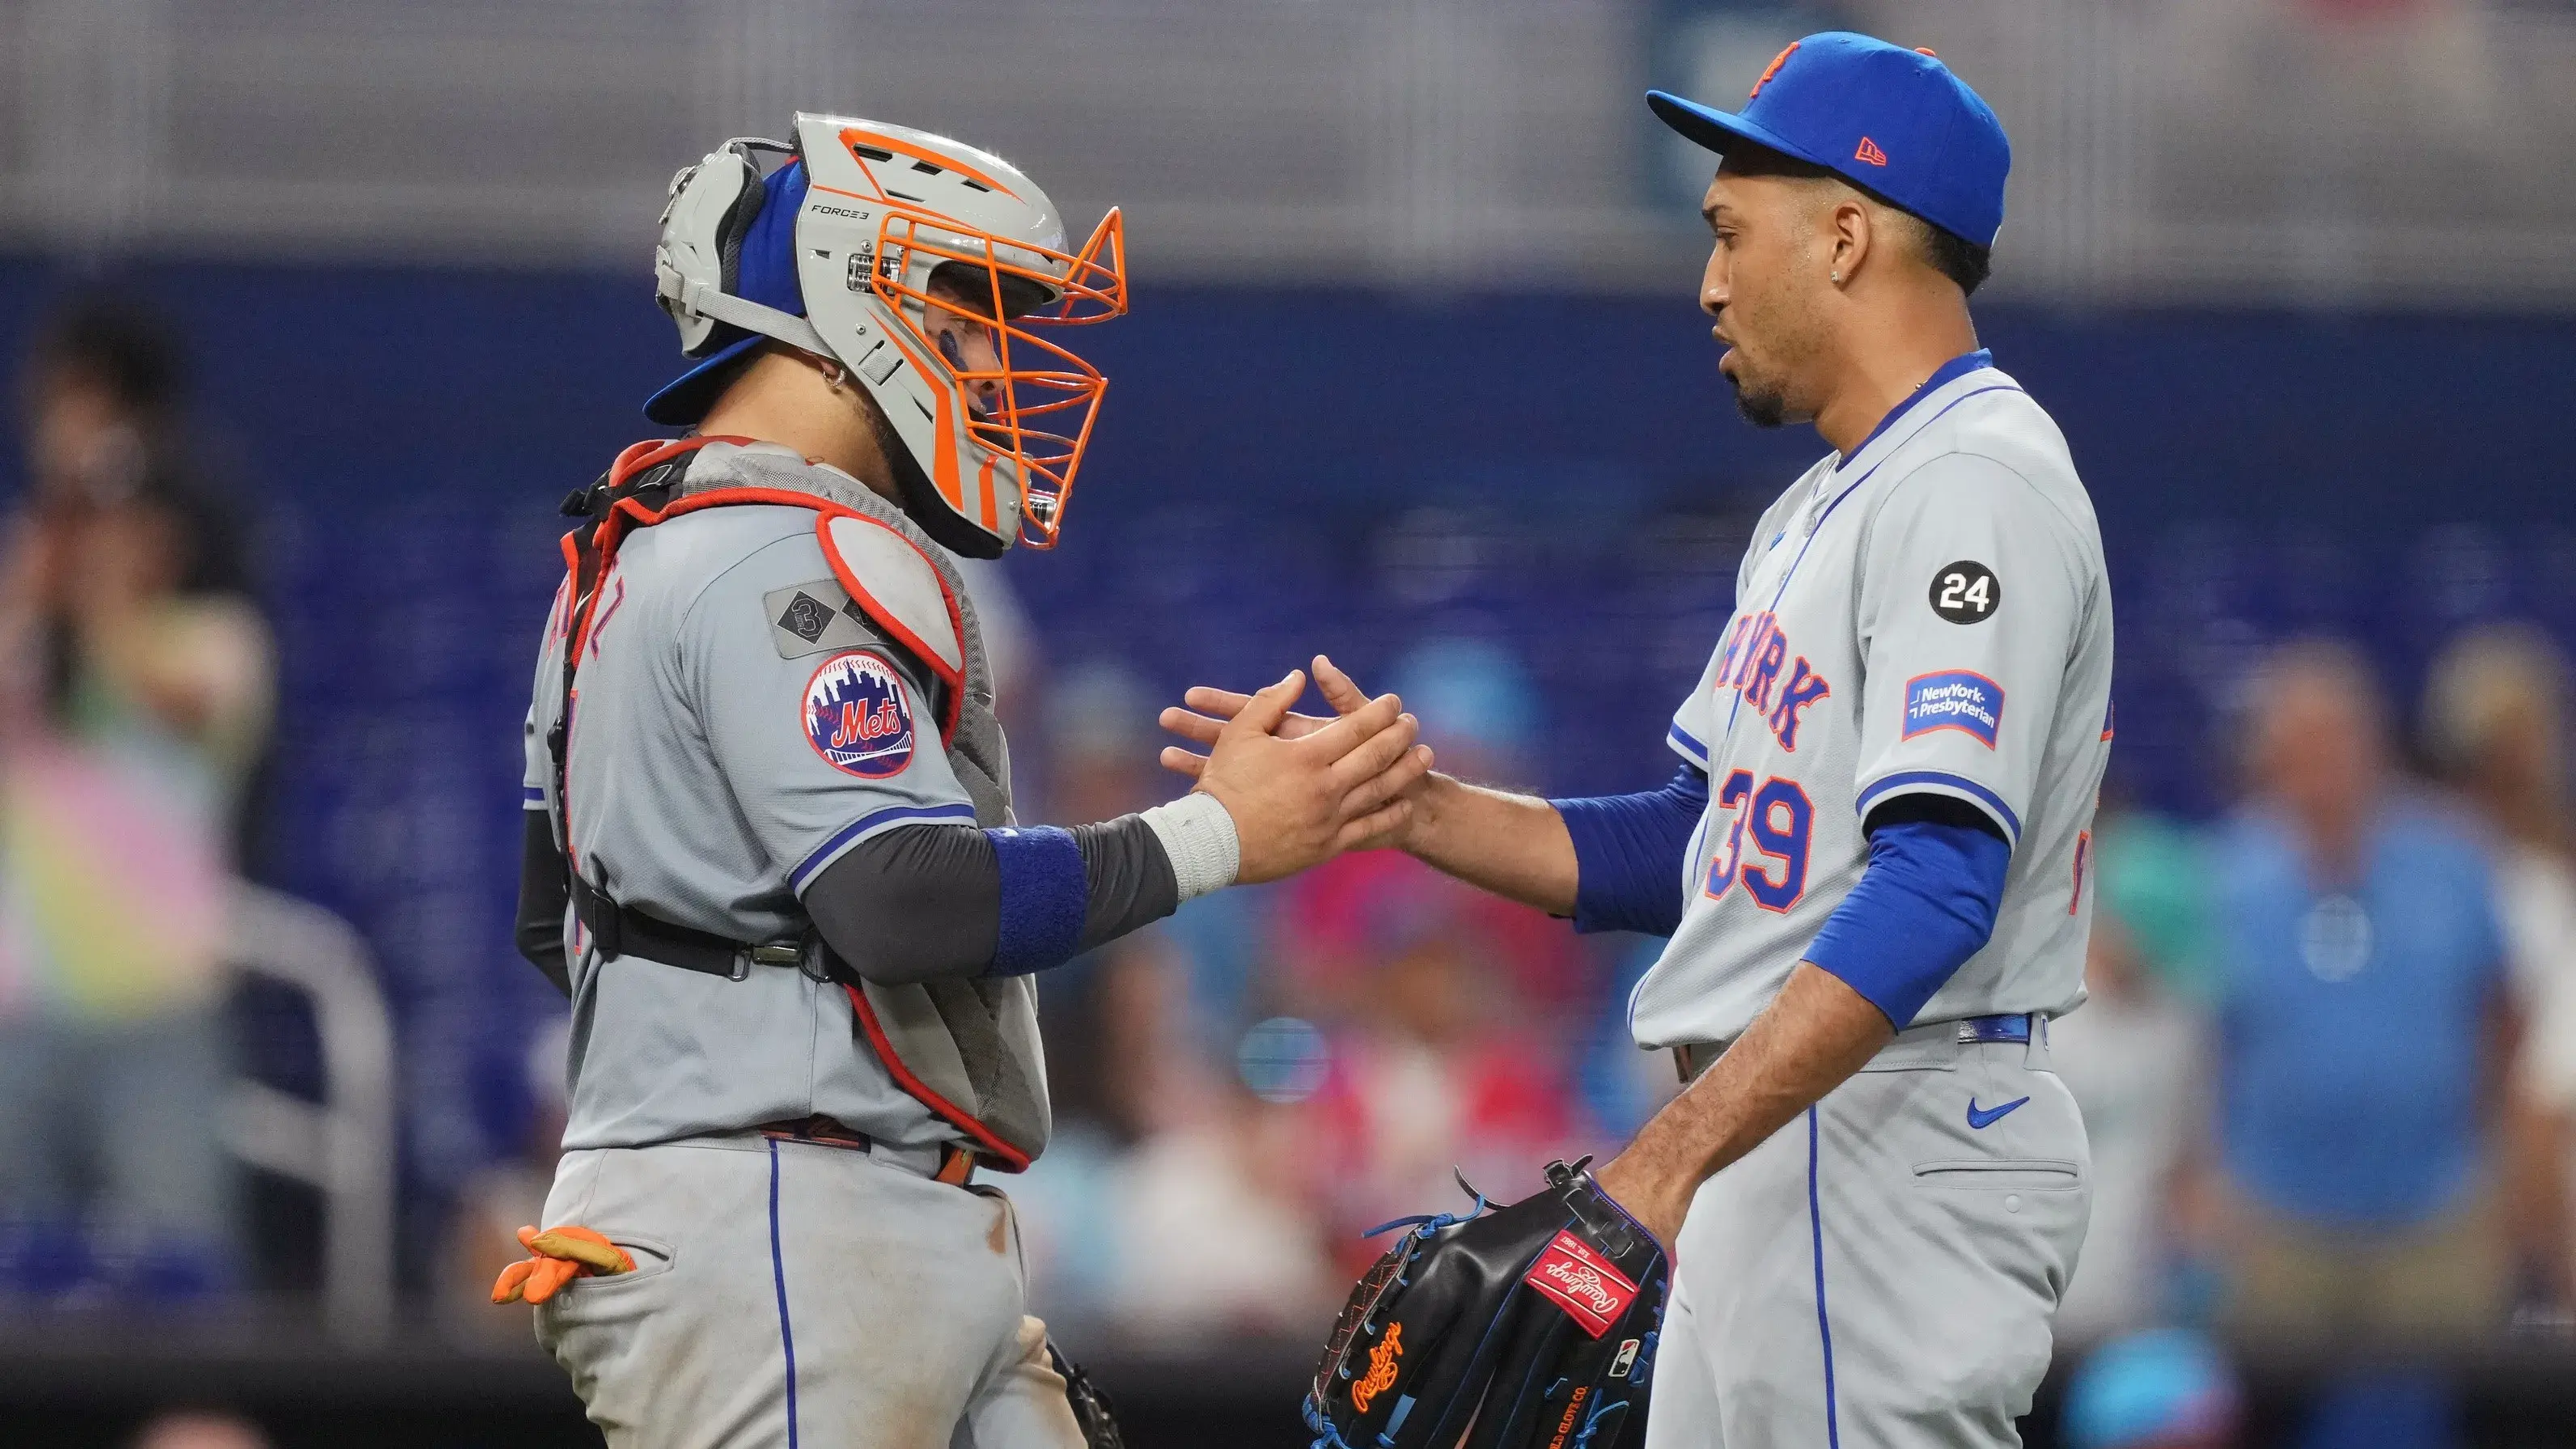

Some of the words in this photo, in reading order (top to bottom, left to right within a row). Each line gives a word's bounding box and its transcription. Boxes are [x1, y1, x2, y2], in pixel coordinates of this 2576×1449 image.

[811, 205, 870, 220] FORCE3
[1939, 573, 1990, 612] 24
[791, 598, 823, 638] 3
[831, 697, 901, 748] Mets
[1919, 697, 1995, 728] Presbyterian
[1704, 768, 1815, 914] 39
[1560, 1236, 1577, 1250] 1887
[1545, 1261, 1619, 1313] Rawlings
[1352, 1321, 1404, 1413] Rawlings
[1557, 1402, 1581, 1434] GLOVE
